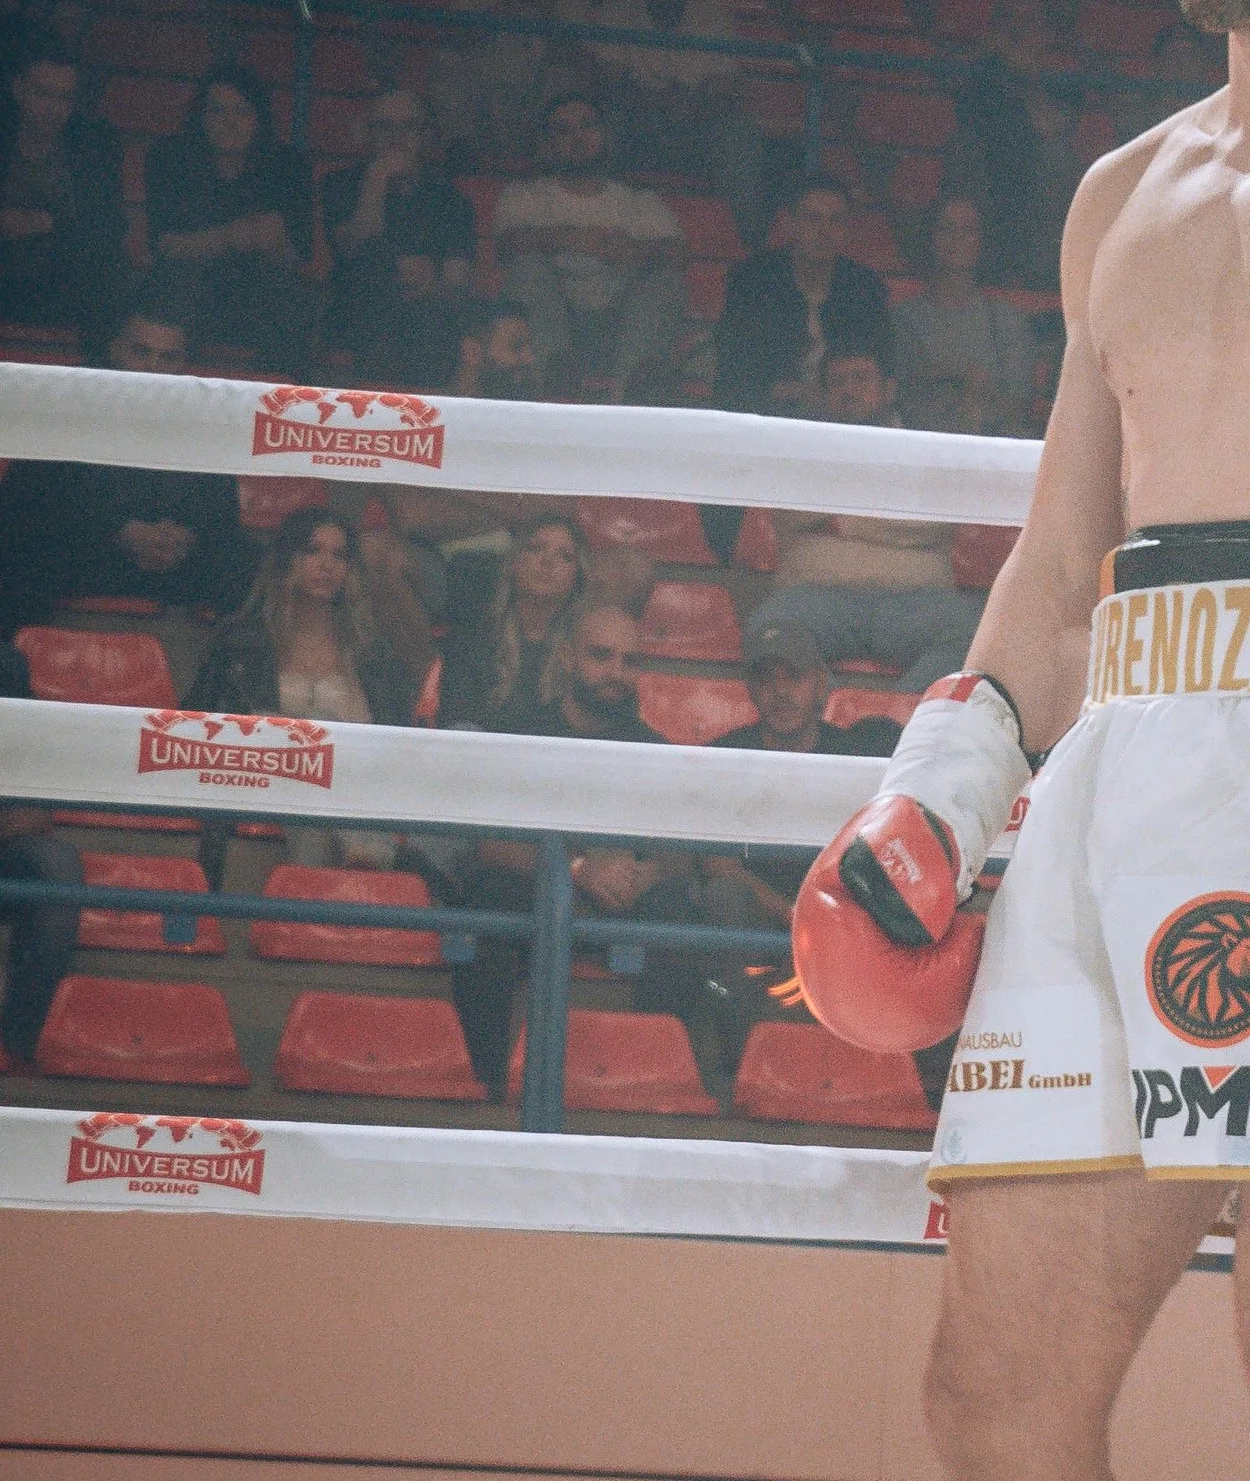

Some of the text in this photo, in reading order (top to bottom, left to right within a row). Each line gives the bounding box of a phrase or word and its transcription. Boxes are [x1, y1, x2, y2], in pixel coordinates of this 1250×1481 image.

[264, 421, 435, 460] UNIVERSUM
[312, 454, 383, 469] BOXING
[151, 737, 325, 778] UNIVERSUM
[199, 772, 270, 789] BOXING
[1028, 1072, 1092, 1089] GmbH
[80, 1146, 255, 1184] UNIVERSUM
[128, 1180, 200, 1196] BOXING
